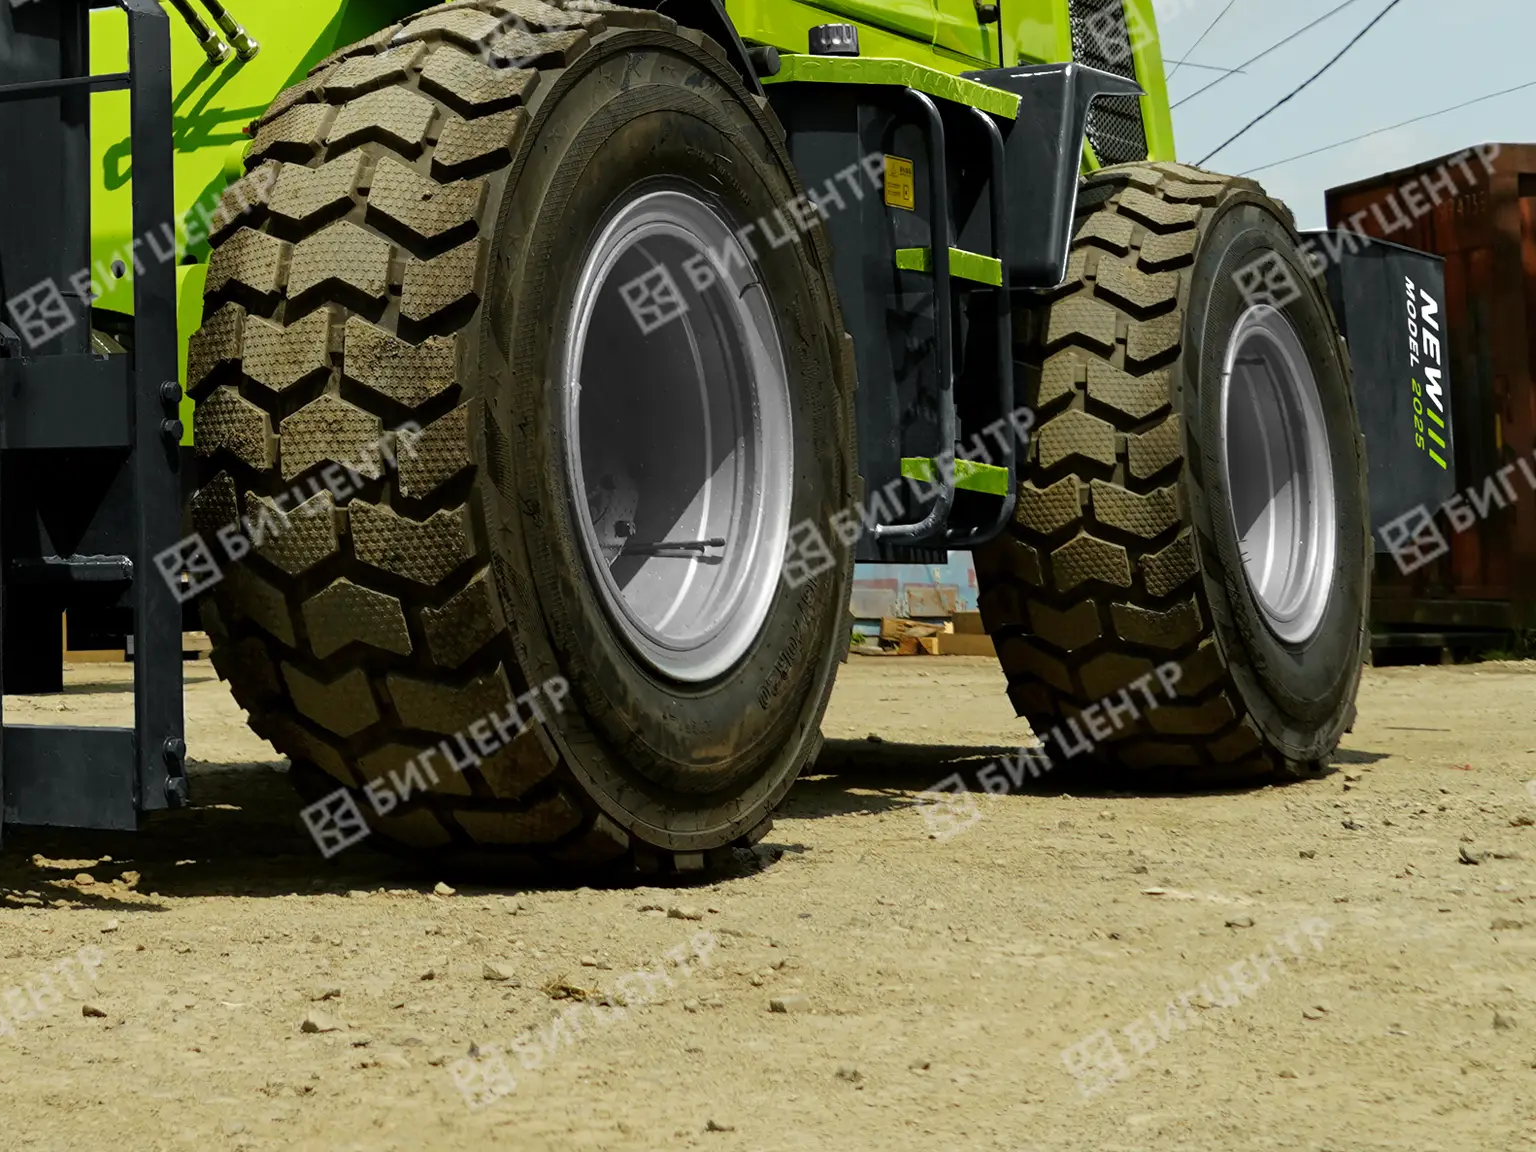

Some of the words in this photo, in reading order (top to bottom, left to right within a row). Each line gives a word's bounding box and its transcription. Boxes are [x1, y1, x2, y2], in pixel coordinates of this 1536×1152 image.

[1404, 275, 1420, 368] MODEL
[1419, 288, 1444, 413] NEW
[1411, 377, 1425, 451] 2025
